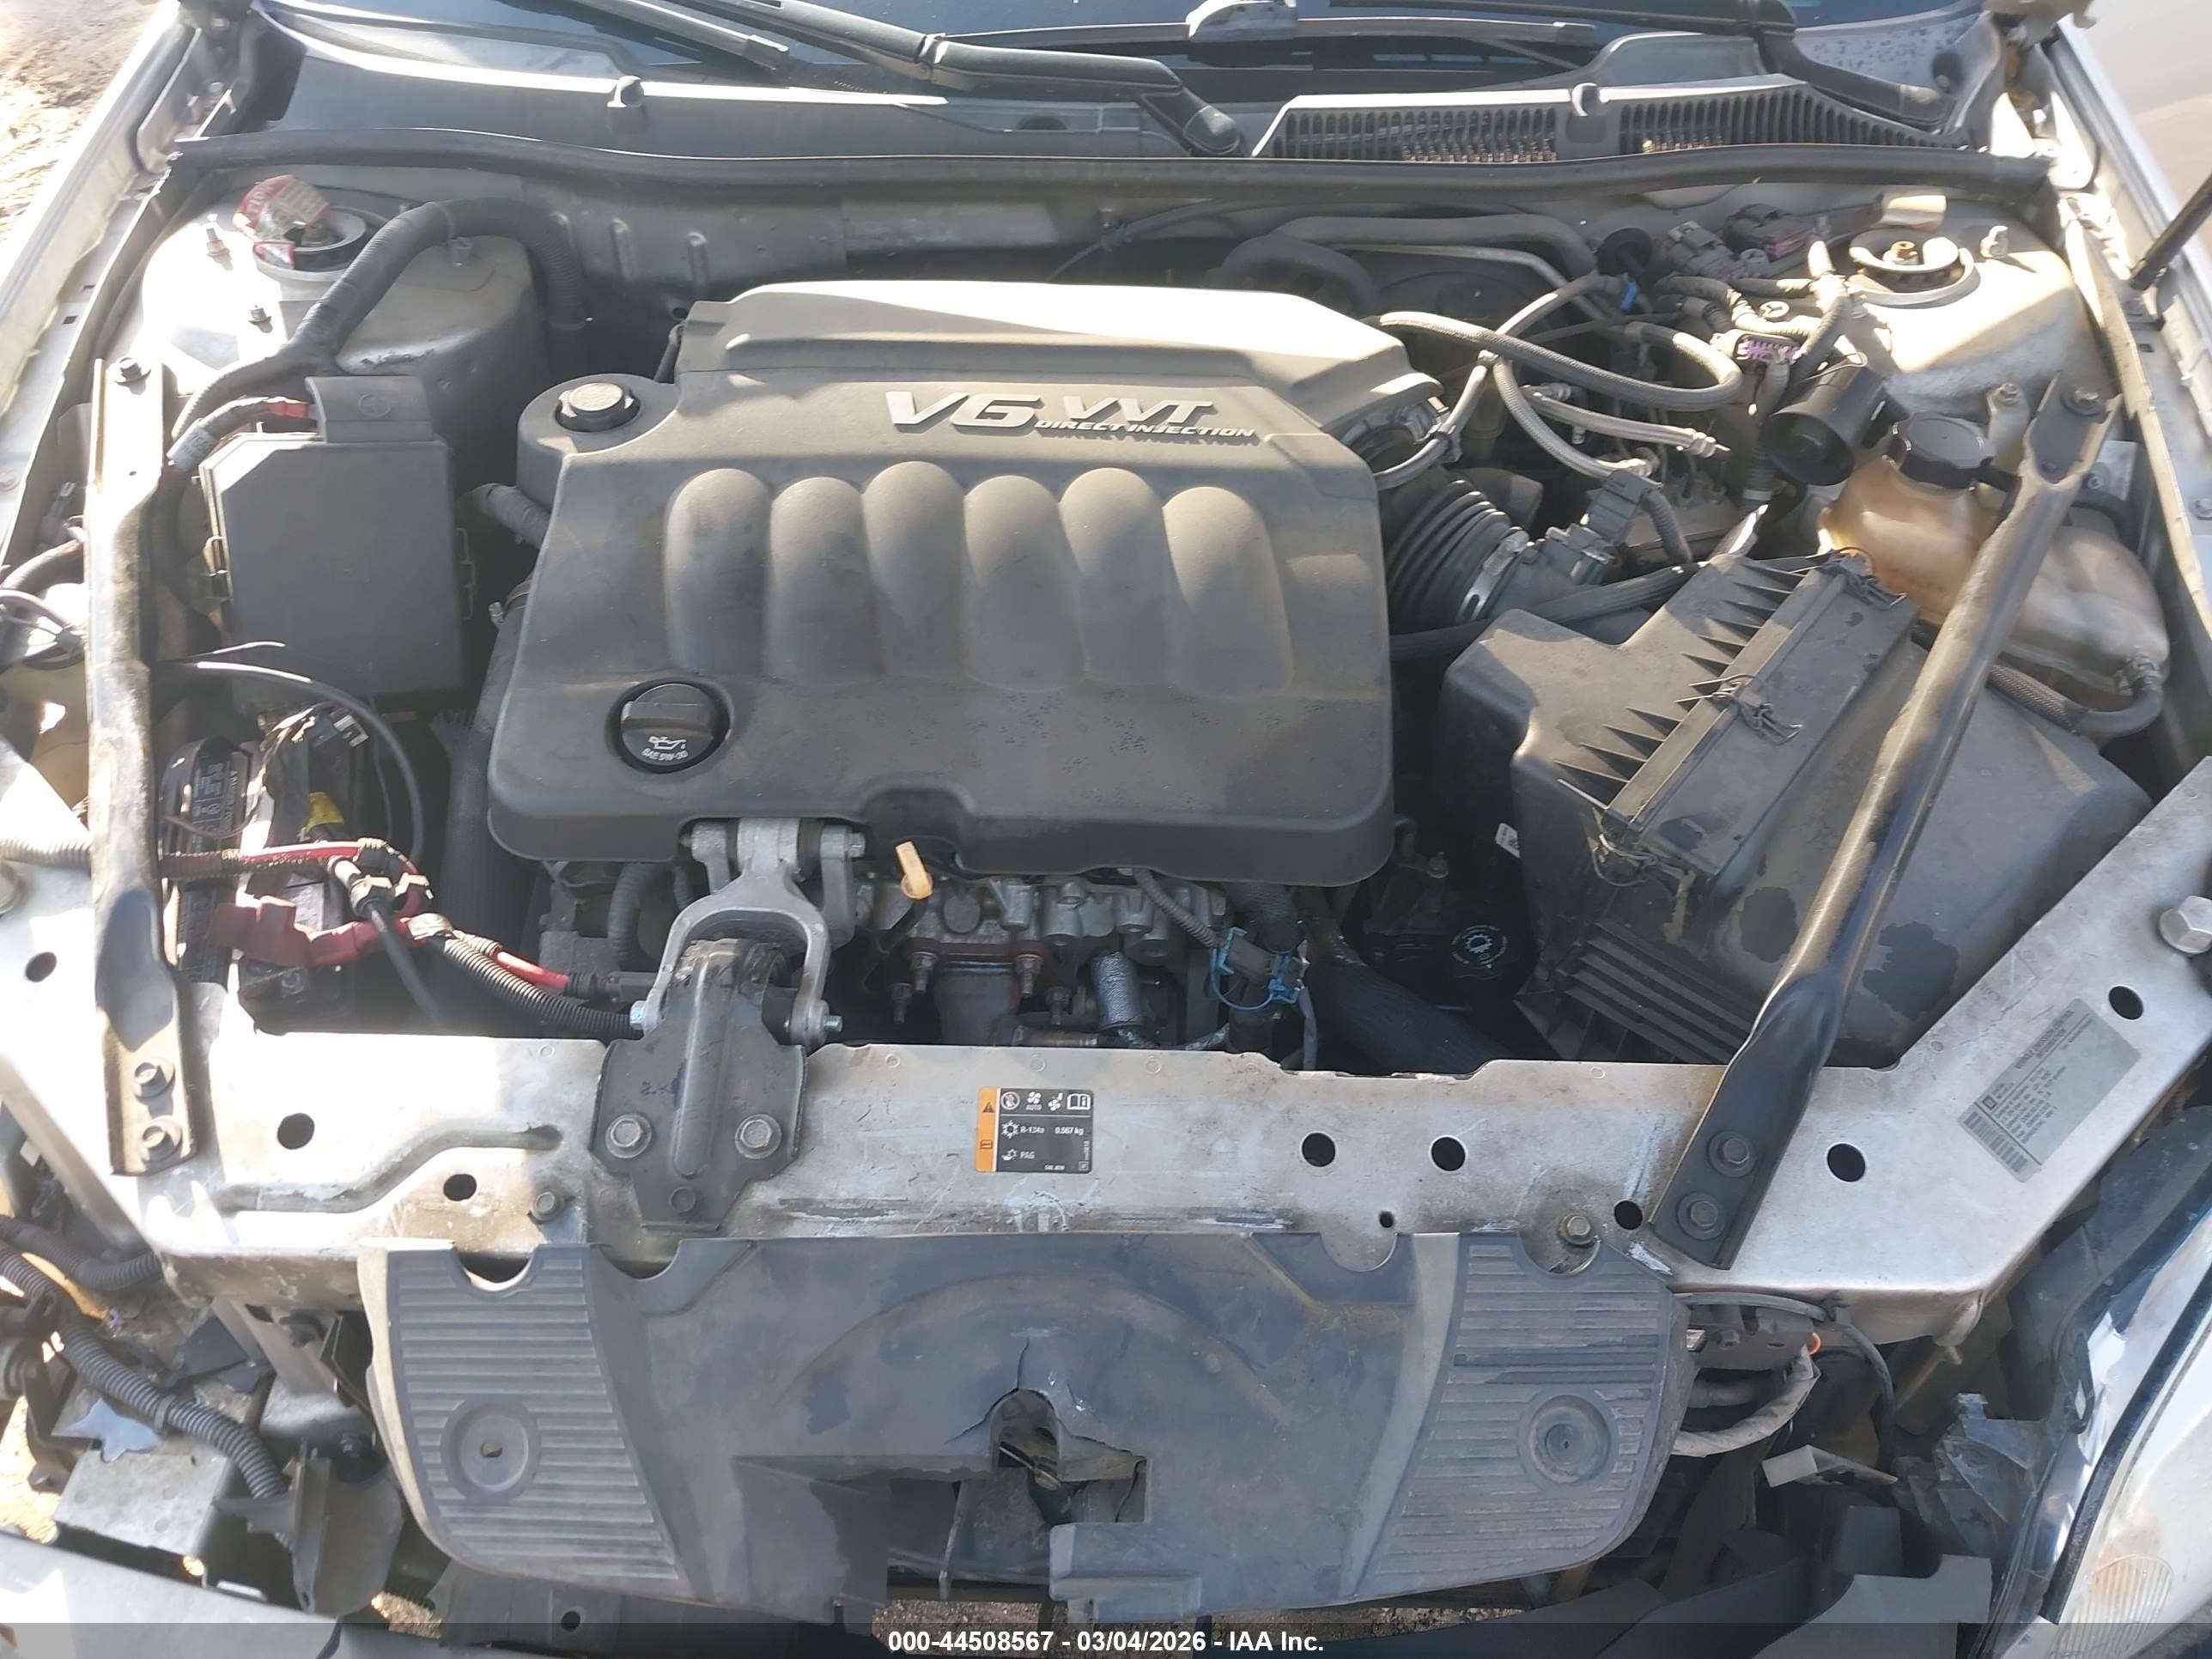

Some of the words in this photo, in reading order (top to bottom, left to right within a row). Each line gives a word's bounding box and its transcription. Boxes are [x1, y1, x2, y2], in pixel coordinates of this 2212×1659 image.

[886, 391, 1041, 428] V6
[1063, 395, 1212, 424] VVT
[1034, 420, 1123, 433] DIRECT
[1126, 424, 1255, 437] INJECTION
[641, 748, 659, 759] SAE
[659, 750, 688, 761] 5W-30
[1054, 1126, 1074, 1134] 0.567
[1074, 1127, 1085, 1136] kg
[1019, 1151, 1036, 1159] PAG
